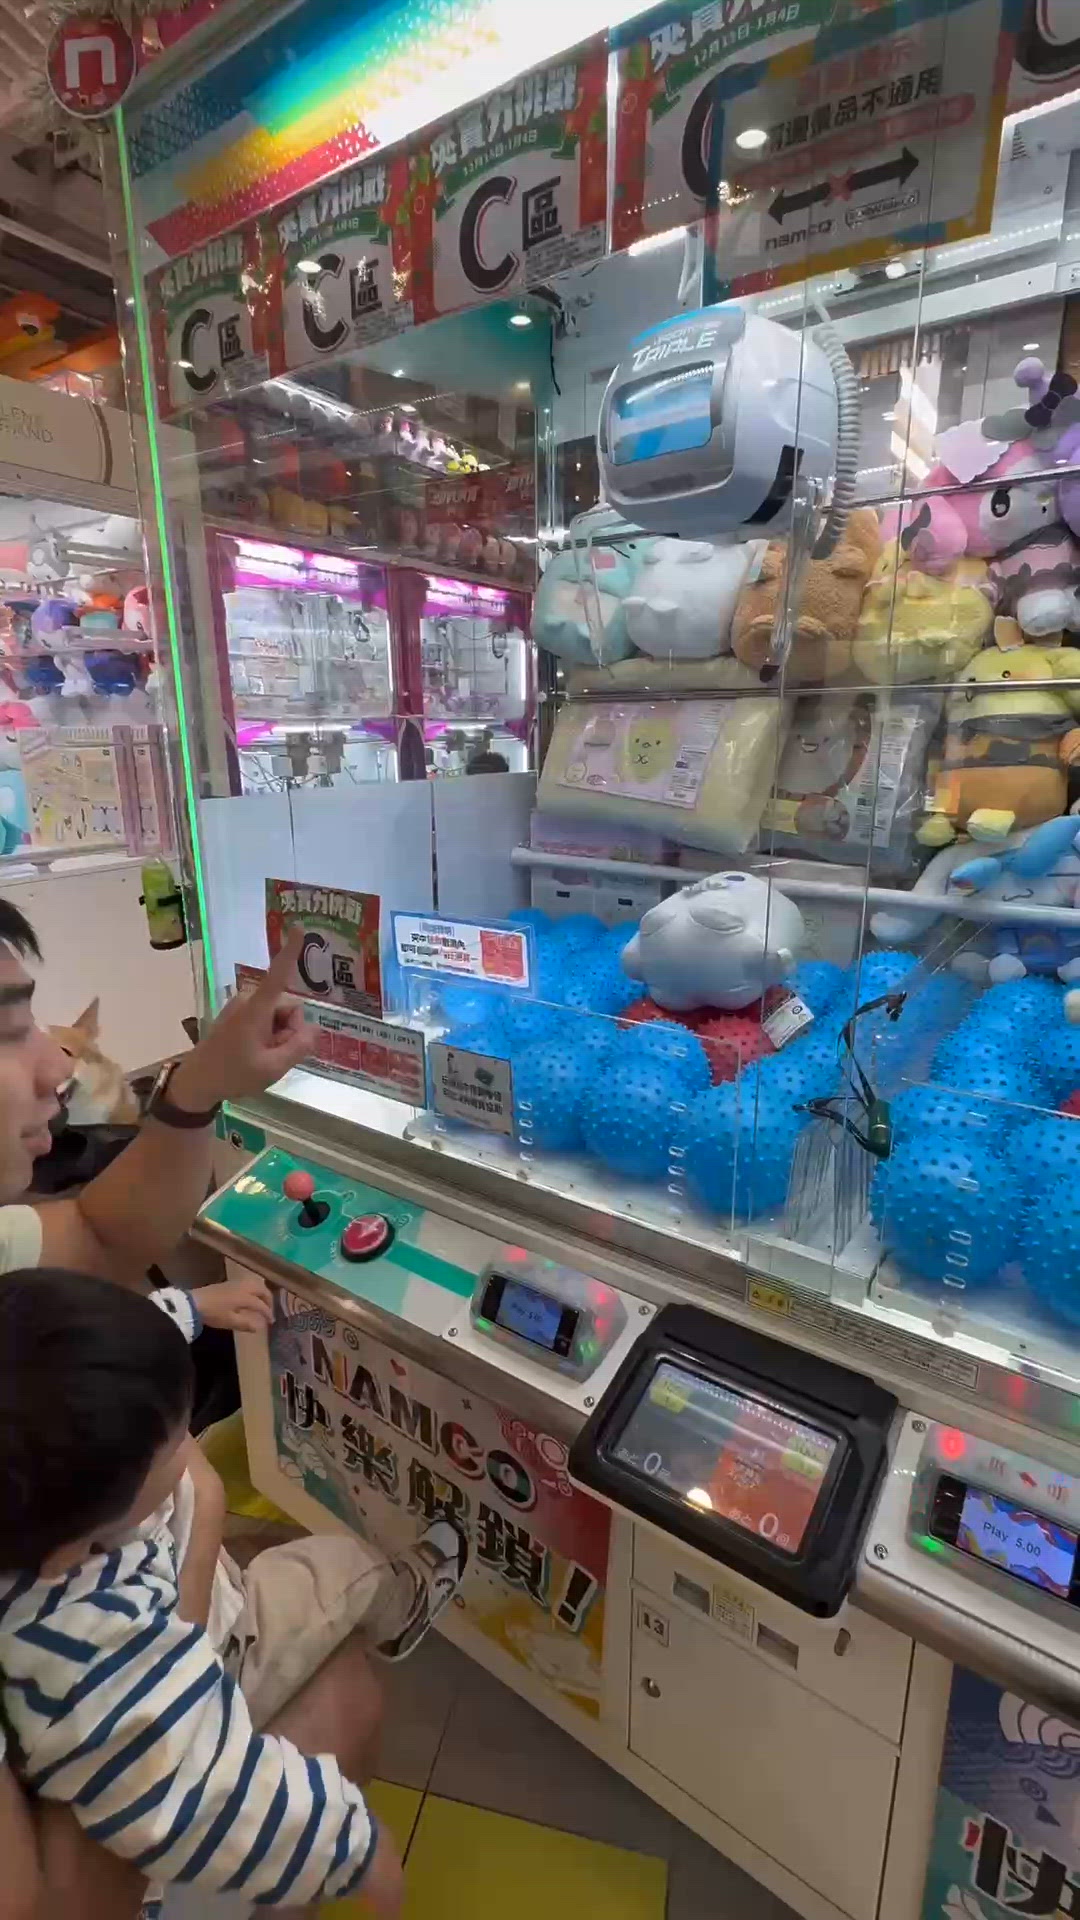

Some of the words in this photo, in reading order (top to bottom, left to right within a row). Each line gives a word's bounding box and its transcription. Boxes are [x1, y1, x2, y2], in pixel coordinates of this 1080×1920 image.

[764, 218, 832, 251] namco
[311, 1335, 534, 1510] NAMCO
[983, 1521, 1009, 1542] Play
[1015, 1537, 1041, 1558] 5.00
